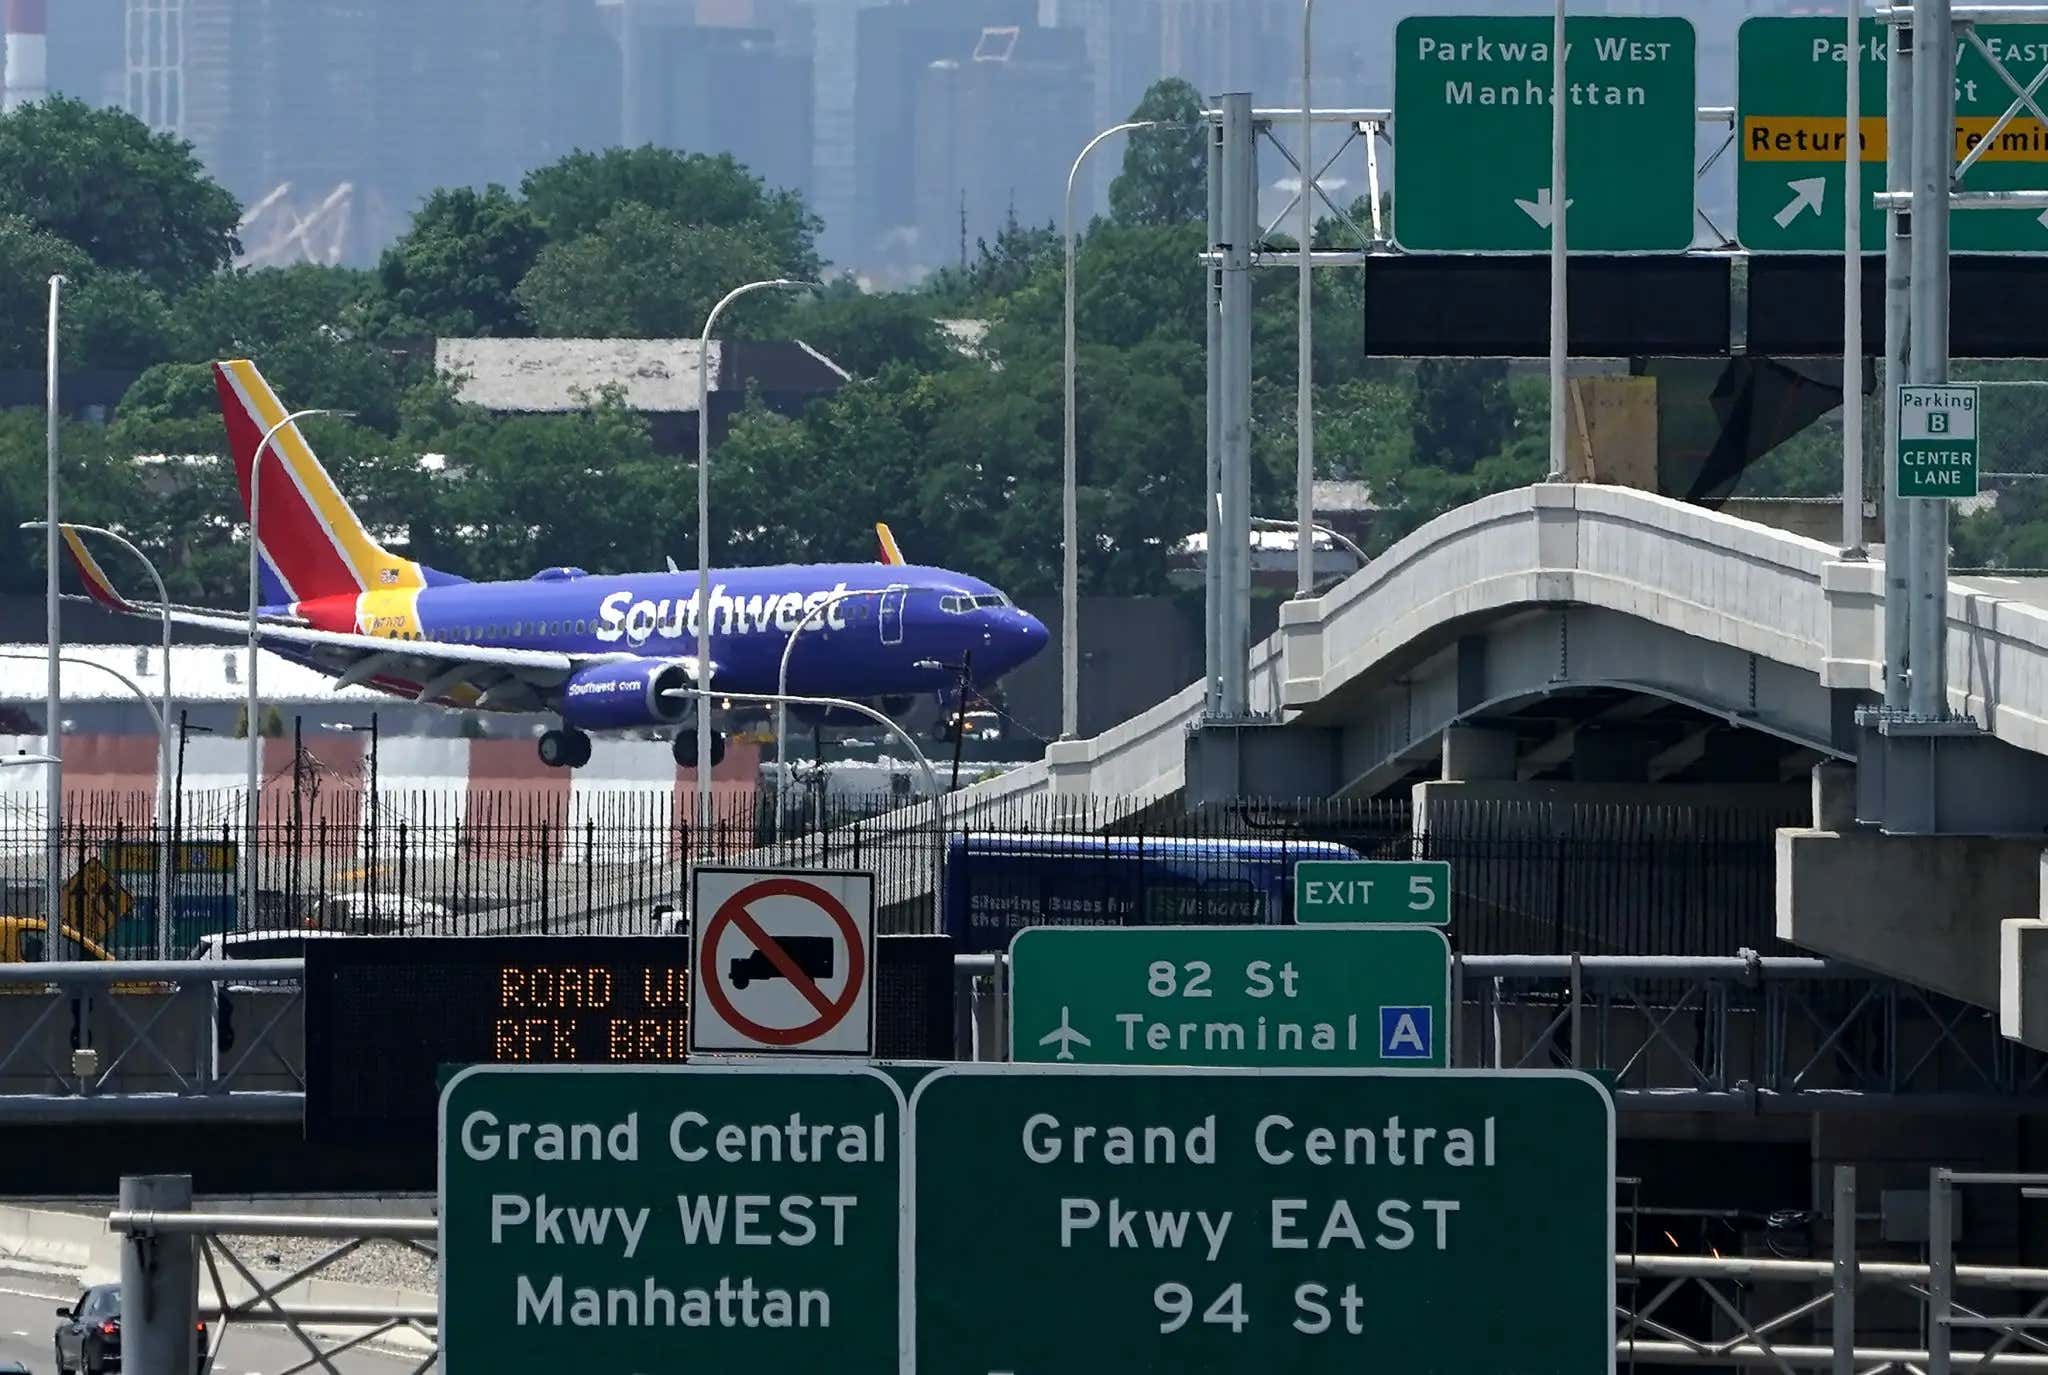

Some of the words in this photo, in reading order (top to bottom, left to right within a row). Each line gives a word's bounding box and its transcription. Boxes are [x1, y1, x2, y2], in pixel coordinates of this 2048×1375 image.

[1594, 37, 1671, 62] WEST
[1904, 393, 1973, 411] Parking
[1931, 415, 1945, 431] B
[1903, 451, 1972, 466] CENTER
[1914, 470, 1961, 484] LANE
[596, 582, 847, 642] Southwest
[568, 679, 641, 697] Southwestcom
[1306, 881, 1374, 905] EXIT
[1407, 876, 1436, 911] 5
[502, 968, 611, 1008] ROAD
[1147, 960, 1212, 997] 82
[1245, 960, 1299, 998] St
[496, 1019, 576, 1059] RFK
[1116, 1014, 1356, 1051] Terminal
[1388, 1013, 1424, 1051] A
[461, 1111, 639, 1161] Grand
[669, 1111, 885, 1163] Central
[1022, 1113, 1216, 1164] Grand
[1255, 1114, 1495, 1166] Central
[491, 1194, 650, 1258] Pkwy
[677, 1195, 858, 1246] WEST
[1061, 1197, 1233, 1261] Pkwy
[1271, 1199, 1460, 1250] EAST
[516, 1275, 830, 1327] Manhattan
[1153, 1282, 1249, 1334] 94
[1292, 1283, 1364, 1334] St
